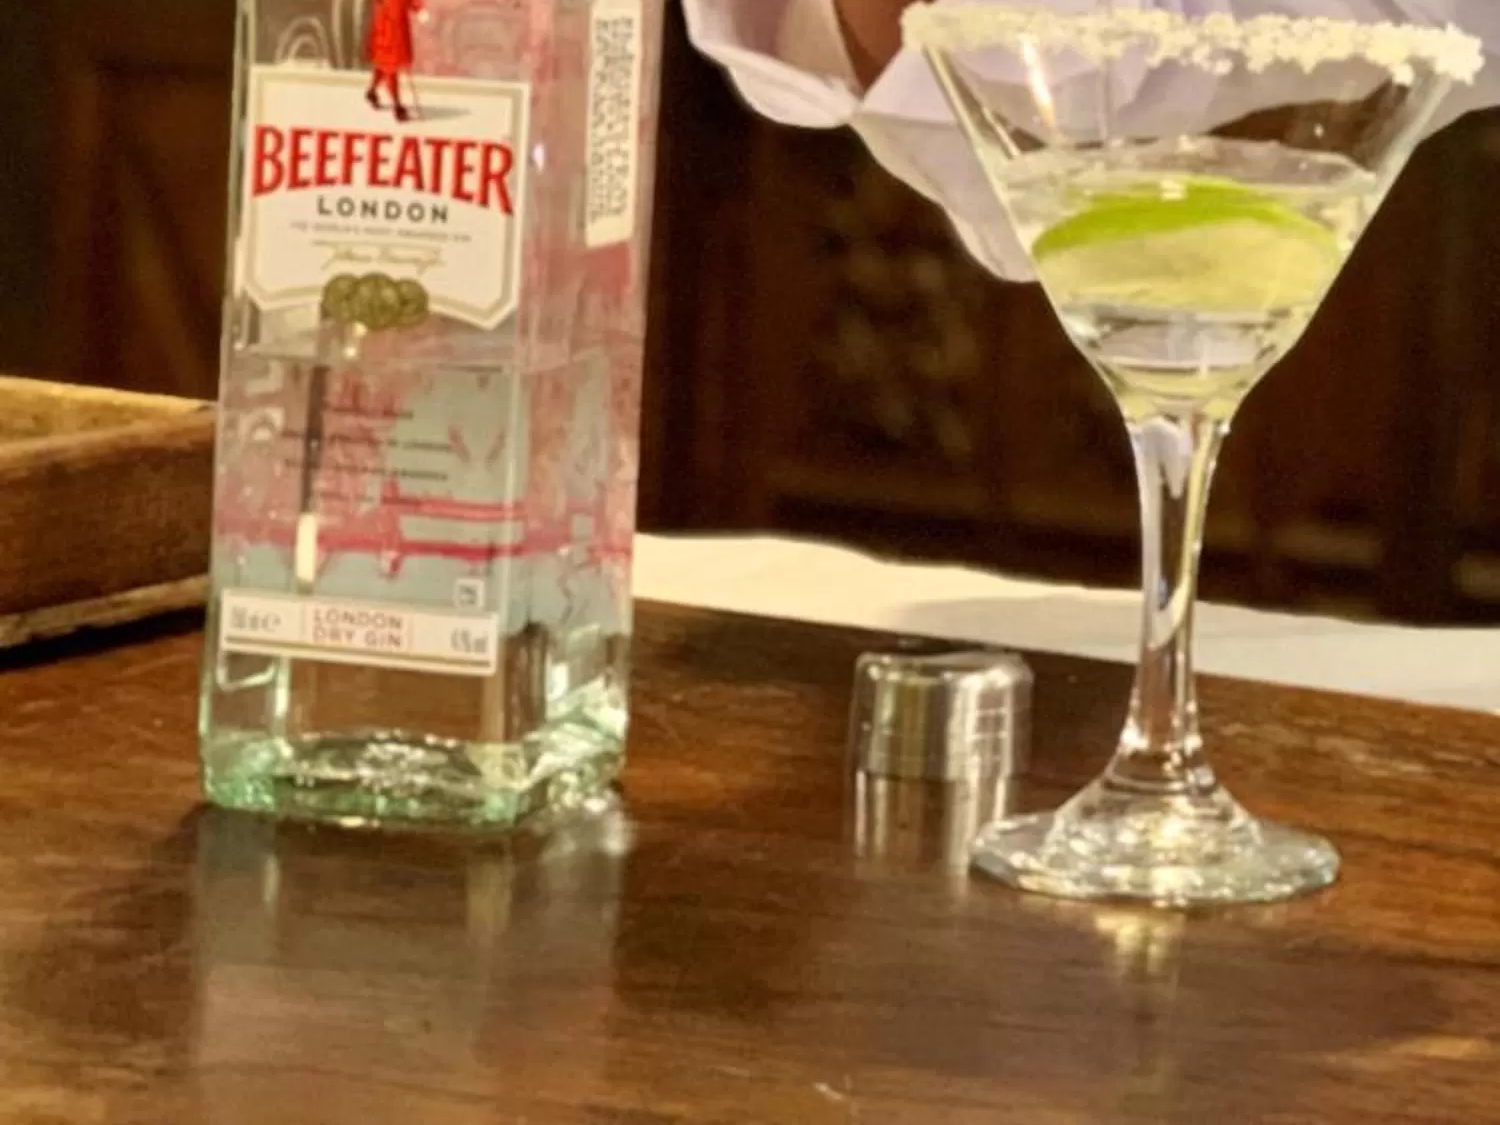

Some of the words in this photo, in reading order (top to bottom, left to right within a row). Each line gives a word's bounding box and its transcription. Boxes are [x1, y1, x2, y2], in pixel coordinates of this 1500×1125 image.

[252, 125, 514, 216] BEEFEATER
[315, 194, 449, 224] LONDON
[312, 607, 404, 630] LONDON
